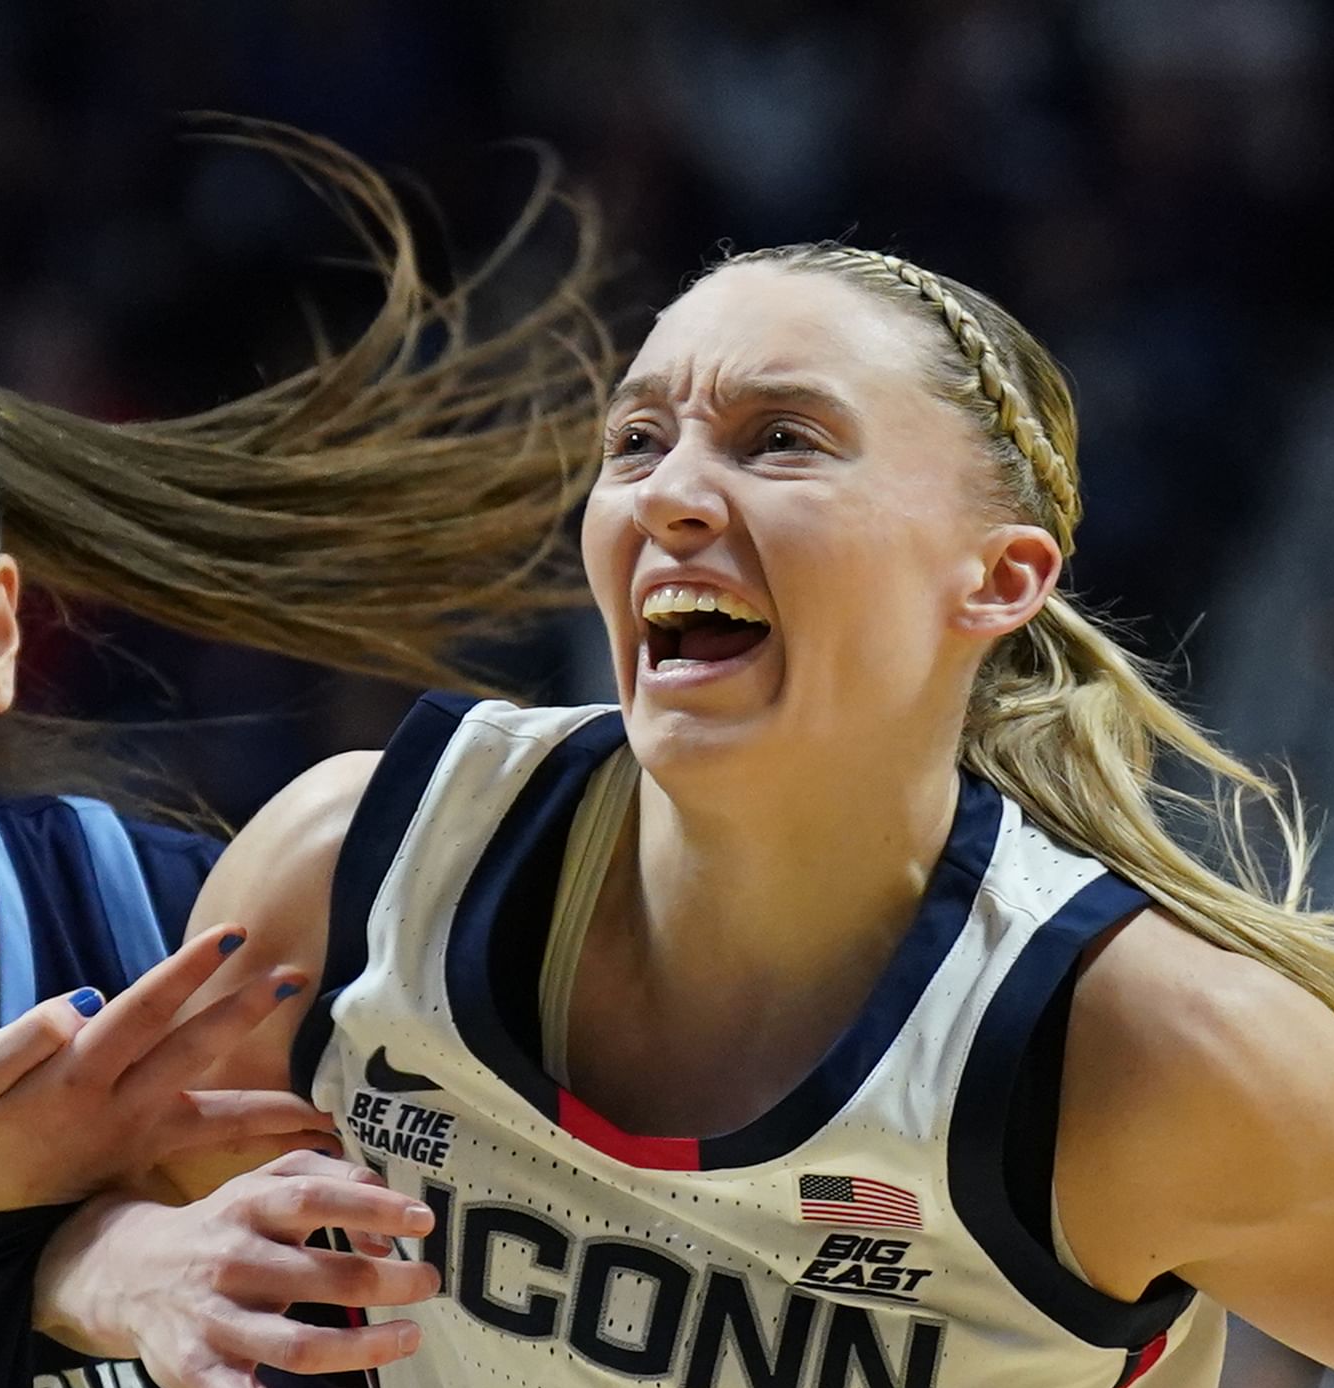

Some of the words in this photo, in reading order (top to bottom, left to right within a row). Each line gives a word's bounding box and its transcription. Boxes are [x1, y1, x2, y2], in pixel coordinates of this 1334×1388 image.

[352, 1092, 391, 1125] BE
[397, 1103, 455, 1139] THE
[347, 1116, 450, 1168] CHANGE
[816, 1233, 912, 1265] BIG
[800, 1258, 933, 1292] EAST
